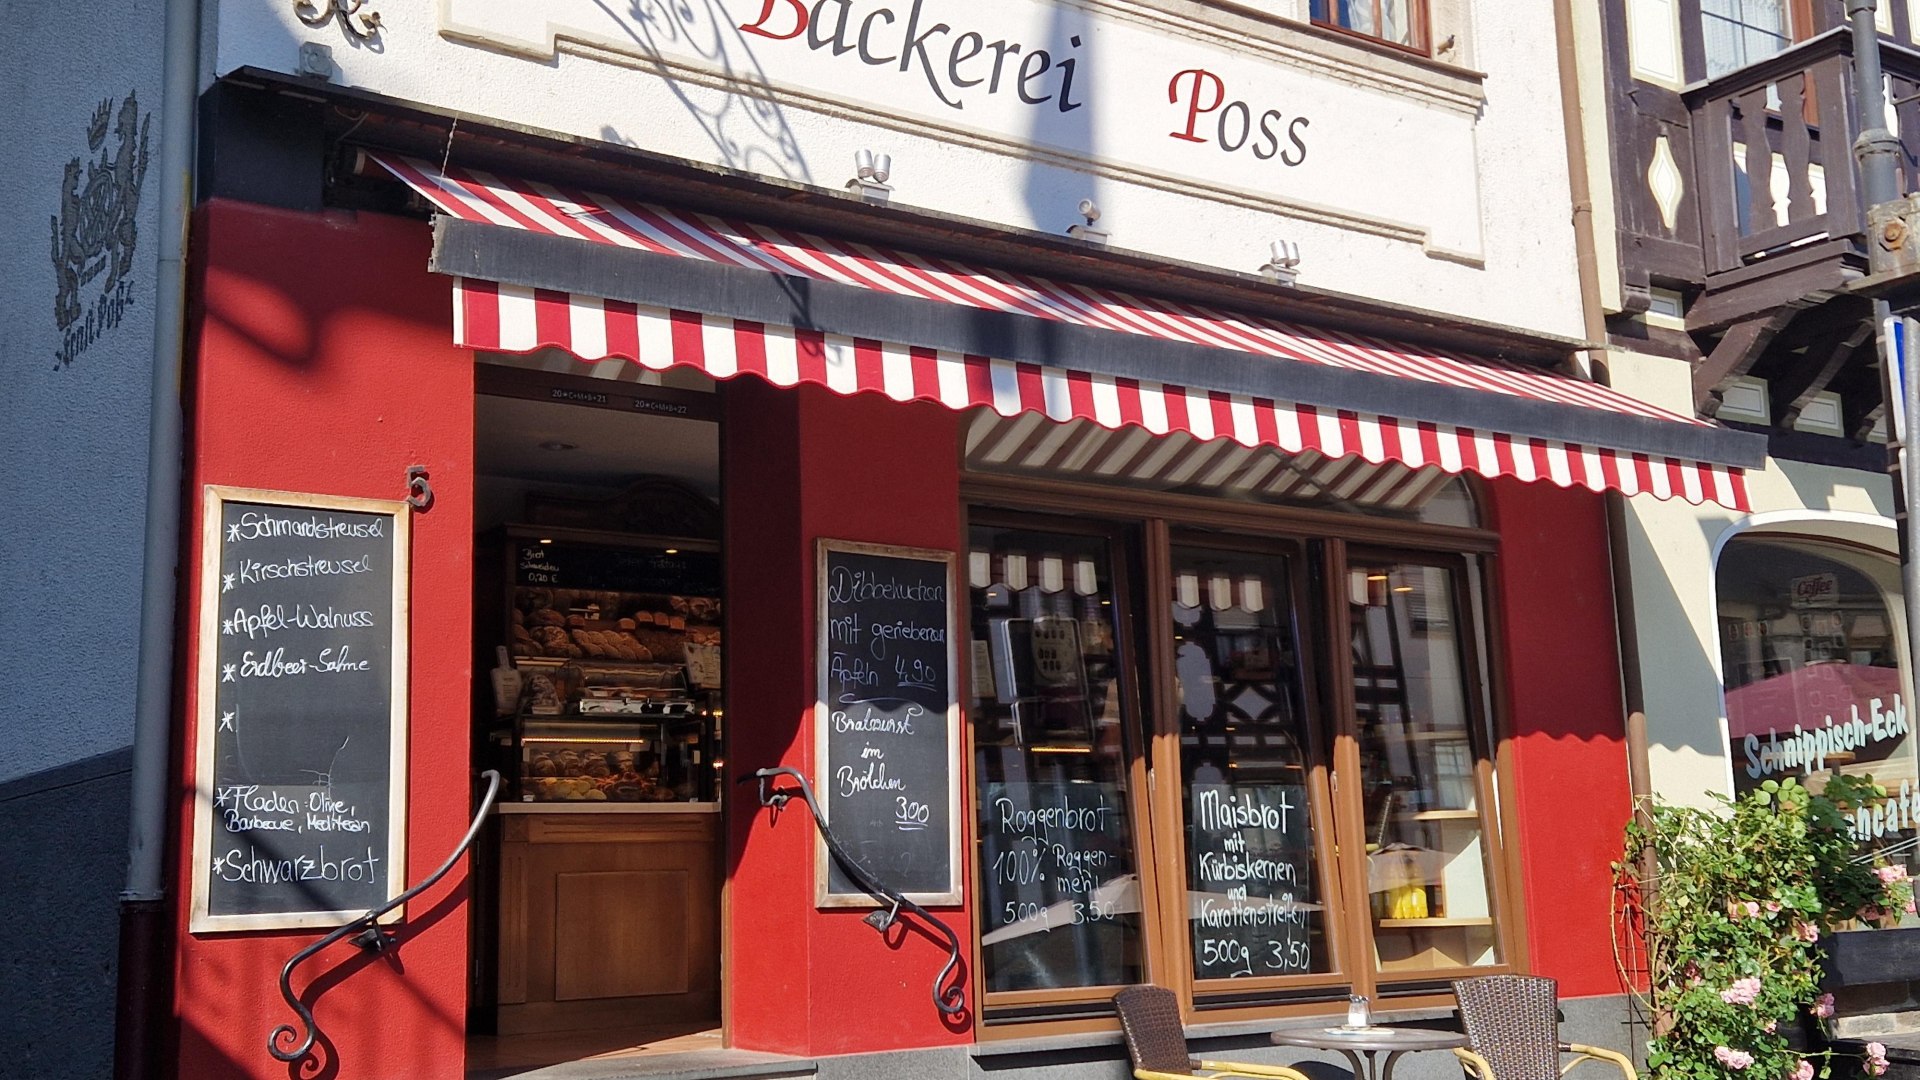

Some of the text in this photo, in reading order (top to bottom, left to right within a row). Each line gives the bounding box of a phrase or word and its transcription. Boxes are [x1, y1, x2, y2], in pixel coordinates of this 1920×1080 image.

[1168, 68, 1310, 167] Poss
[407, 465, 431, 507] 5
[240, 554, 373, 584] Kirschstreusel
[1797, 576, 1833, 597] Coffee
[233, 604, 374, 640] Apfel-Walnuss
[830, 612, 862, 645] mit
[240, 645, 371, 678] Erdbeer-Sahne
[895, 653, 936, 683] 4,90
[861, 741, 885, 760] im
[1744, 693, 1909, 779] Schnippisch-Eck
[837, 762, 907, 798] Brötchen
[995, 795, 1112, 845] Roggenbrot
[1199, 789, 1295, 834] Maisbrot
[1223, 830, 1246, 854] mit
[222, 845, 381, 884] Schwarzbrot
[993, 844, 1118, 885] 100% Roggen-
[1199, 851, 1298, 888] Kürbiskernen
[1057, 874, 1102, 895] mehl
[1226, 883, 1248, 902] und
[1003, 901, 1051, 932] 500g
[1202, 938, 1310, 978] 500g 3,50
